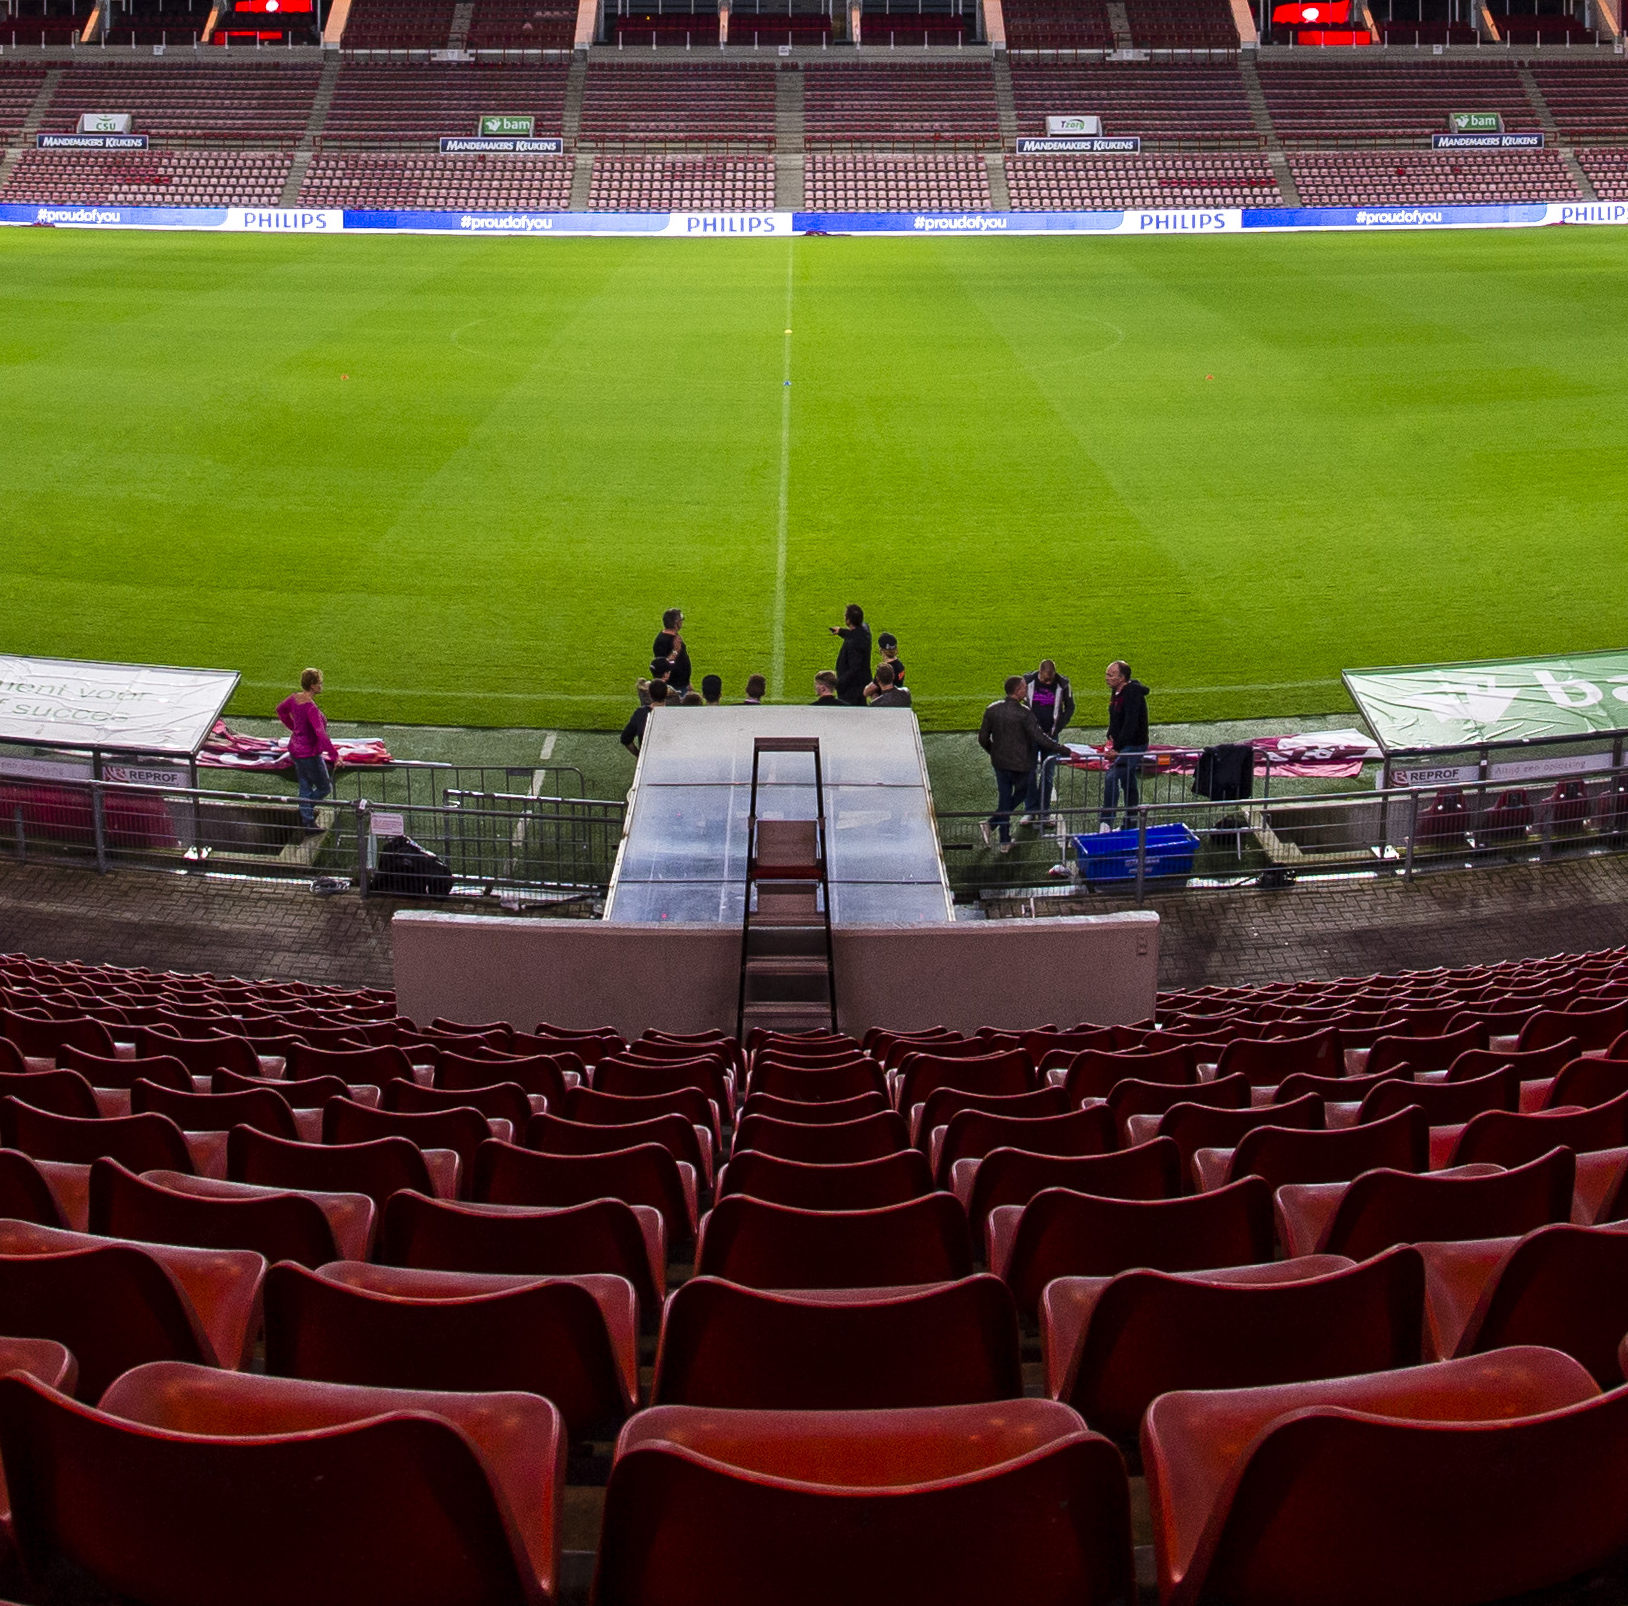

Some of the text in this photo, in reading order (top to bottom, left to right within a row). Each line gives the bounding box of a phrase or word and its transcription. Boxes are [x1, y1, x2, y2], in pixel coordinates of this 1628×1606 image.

[96, 121, 116, 131] CSU
[503, 119, 531, 130] bam
[1470, 115, 1496, 127] bam
[37, 208, 120, 225] #proudofyou
[244, 212, 327, 229] PHILIPS
[460, 215, 552, 232] #proudofyou
[687, 216, 775, 232] PHILIPS
[914, 215, 1007, 232] #proudofyou
[1140, 214, 1225, 230] PHILIPS
[1356, 210, 1442, 227] #proudofyou
[80, 686, 154, 702] voor
[13, 702, 129, 722] succes
[129, 769, 178, 783] REPROF
[1410, 768, 1460, 781] REPROF
